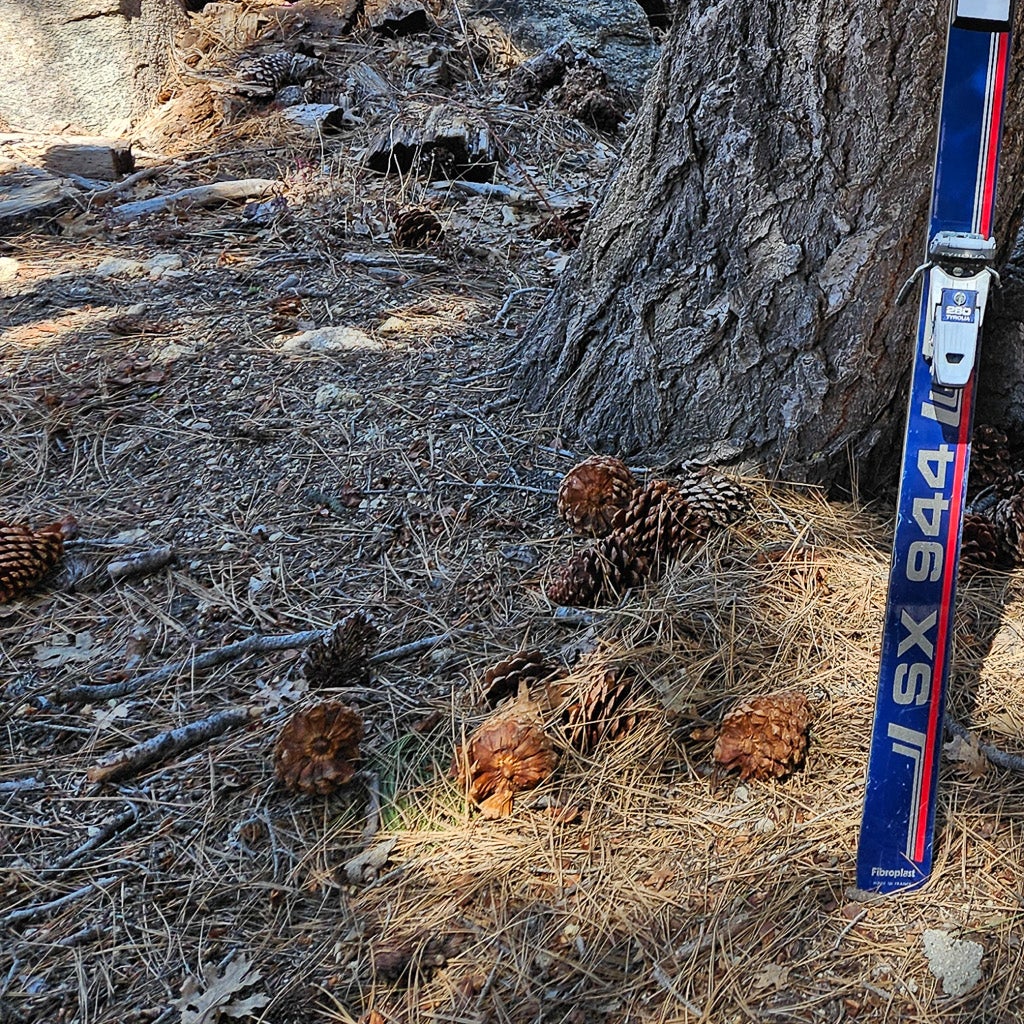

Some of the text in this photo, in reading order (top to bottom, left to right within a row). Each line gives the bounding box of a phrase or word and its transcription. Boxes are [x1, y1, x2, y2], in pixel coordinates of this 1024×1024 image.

[945, 305, 972, 316] 280
[893, 444, 955, 706] SX 944
[871, 866, 916, 879] Fibroplast
